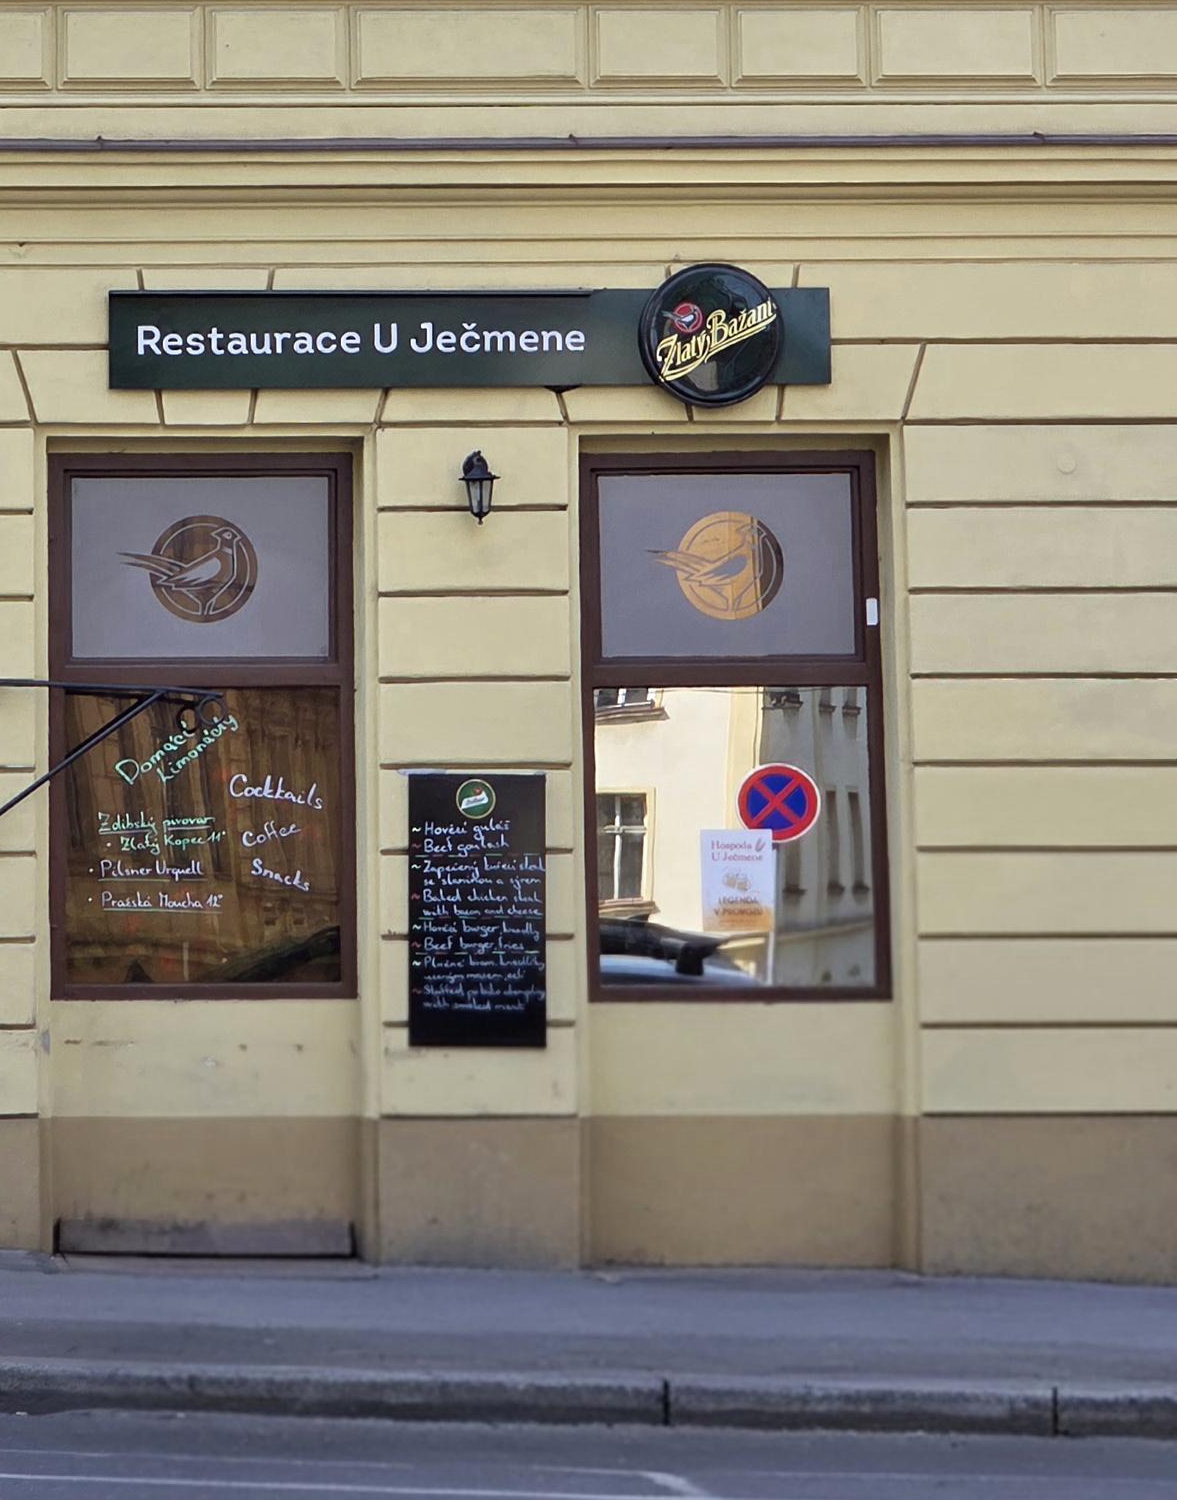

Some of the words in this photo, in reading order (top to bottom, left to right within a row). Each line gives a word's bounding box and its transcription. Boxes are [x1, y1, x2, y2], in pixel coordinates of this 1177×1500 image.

[136, 325, 361, 356] Restaurace
[373, 322, 398, 354] U
[410, 322, 586, 354] Ječmene
[656, 329, 711, 382] Zlatý
[705, 297, 776, 350] Bažant
[115, 720, 196, 785] Domácí
[229, 773, 323, 810] Cocktails
[98, 811, 158, 836] Zdibský
[162, 816, 215, 832] pivovar
[242, 820, 303, 847] Coffee
[100, 860, 152, 877] Pilsner
[155, 860, 204, 881] Urquell
[251, 858, 311, 891] Snacks
